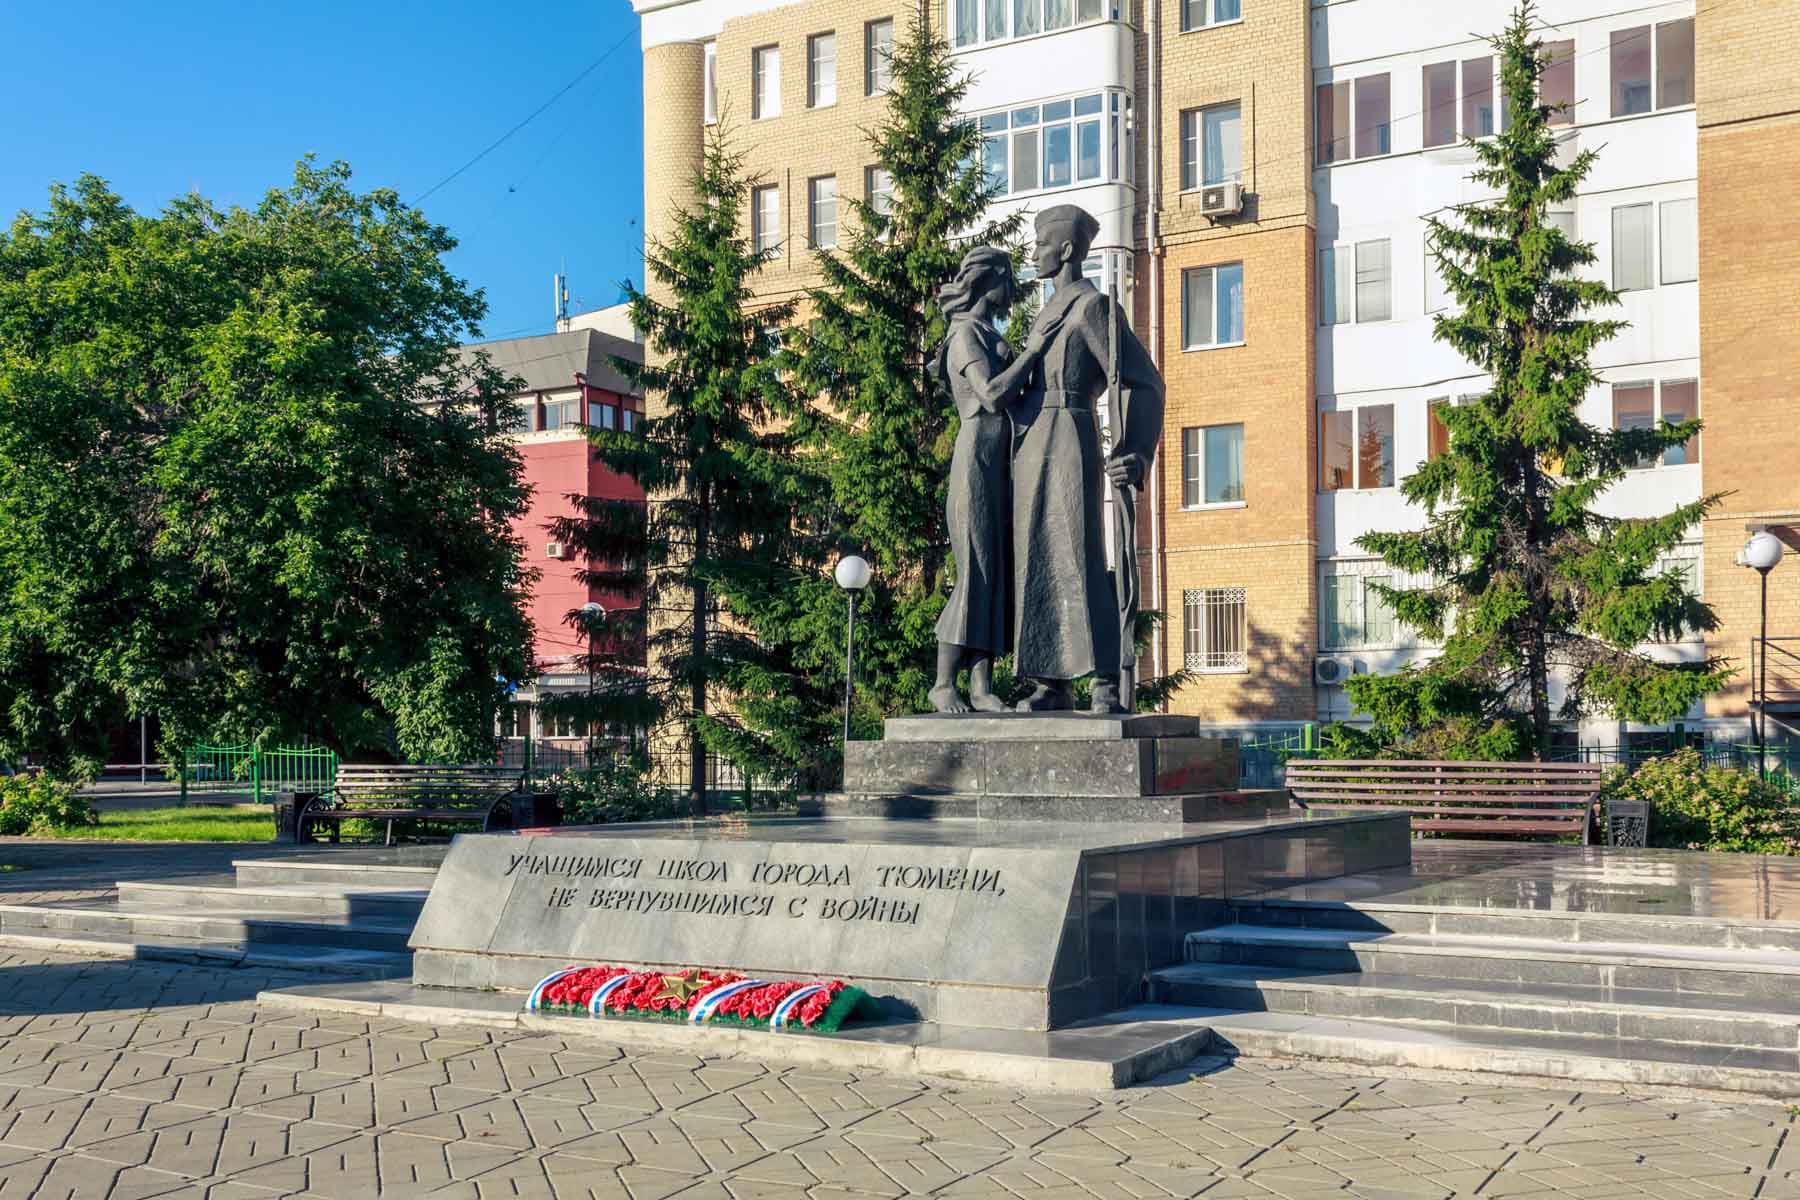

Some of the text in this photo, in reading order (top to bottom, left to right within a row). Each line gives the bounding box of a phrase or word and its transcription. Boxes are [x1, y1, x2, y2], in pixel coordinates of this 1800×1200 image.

[504, 853, 1007, 897] УЧАЩИМСЯ ШКОЛ ГОРОДА ТЮМЕНИ,
[548, 887, 921, 925] НЕ ВЕРНУВШИМСЯ С ВОЙНЫ
